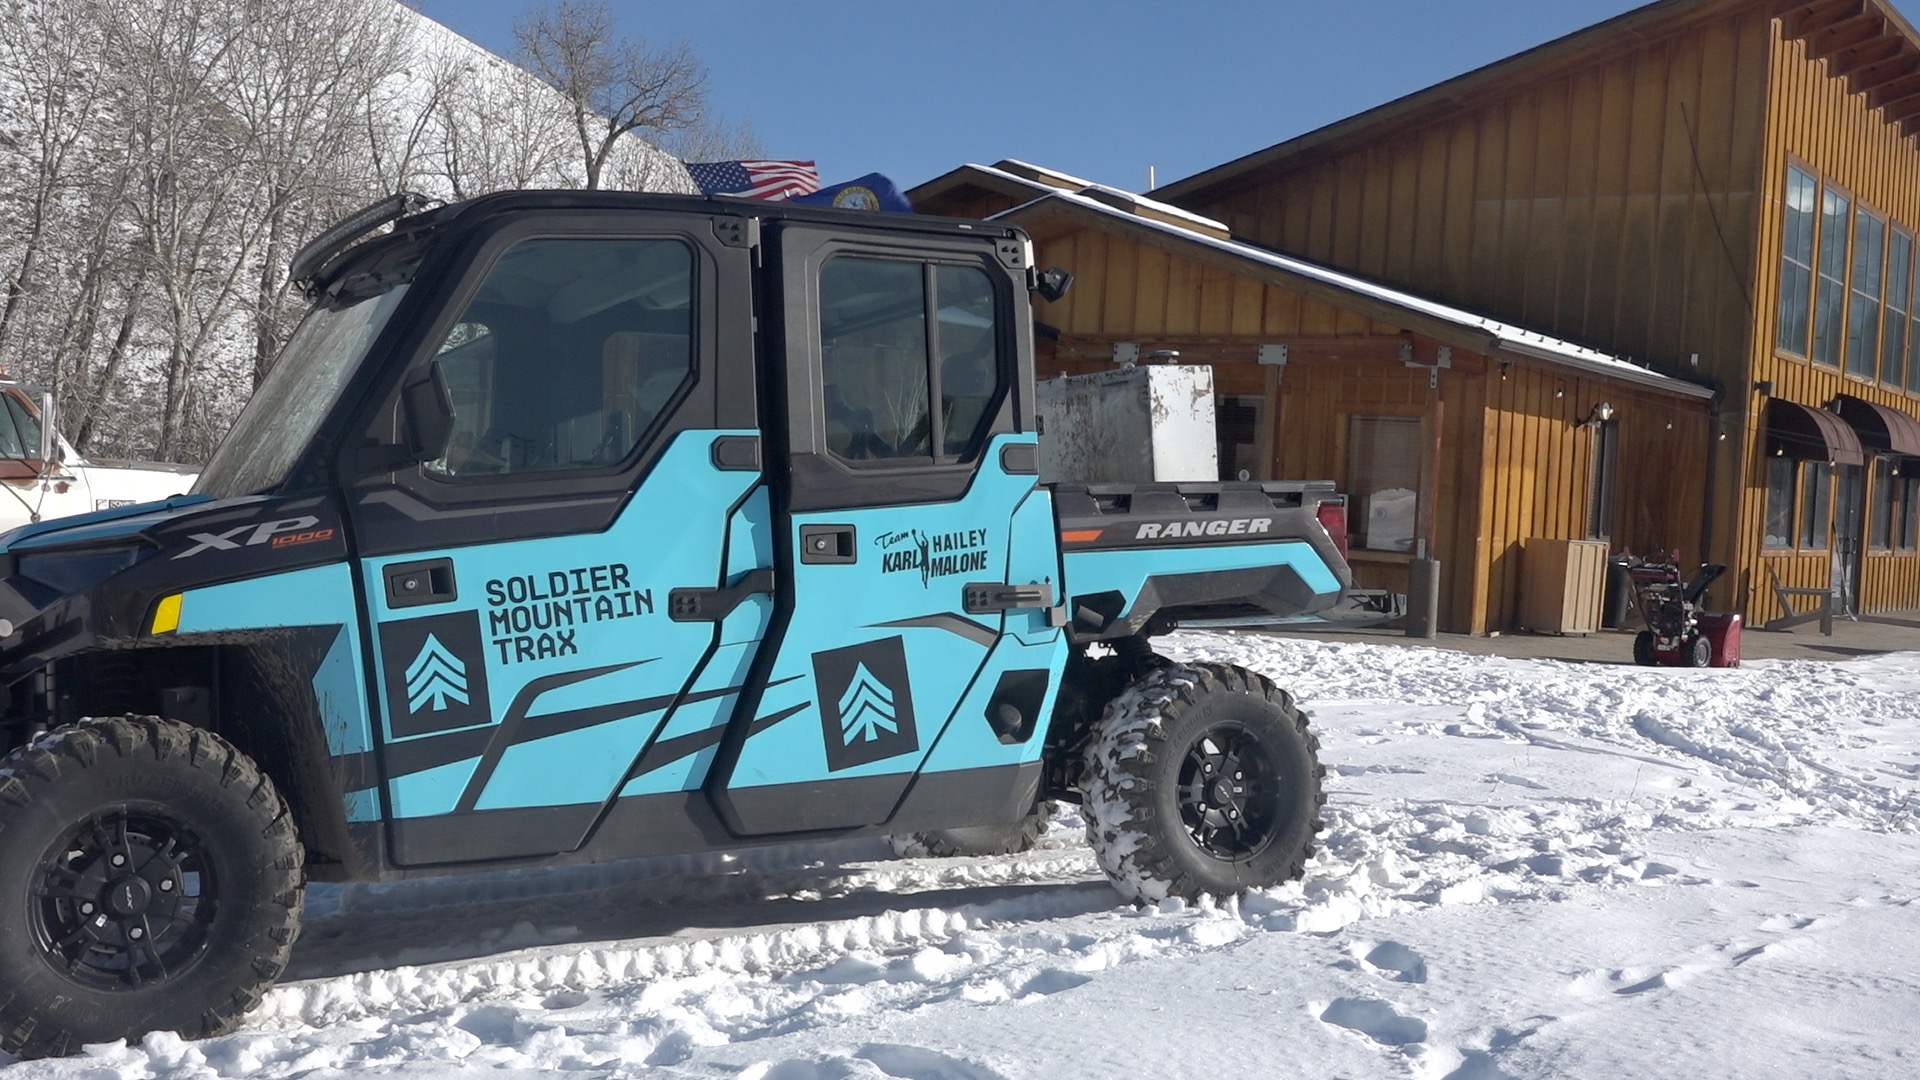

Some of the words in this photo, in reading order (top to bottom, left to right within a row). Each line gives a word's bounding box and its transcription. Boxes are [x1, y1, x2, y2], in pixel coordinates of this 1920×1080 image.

[170, 515, 320, 561] XP
[271, 529, 335, 546] 1000
[874, 531, 909, 549] Team
[932, 528, 987, 552] HAILEY
[1135, 518, 1272, 539] RANGER
[882, 549, 921, 574] KARL
[930, 550, 988, 577] MALONE
[486, 563, 631, 606] SOLDIER
[489, 588, 654, 636] MOUNTAIN
[493, 628, 578, 665] TRAX
